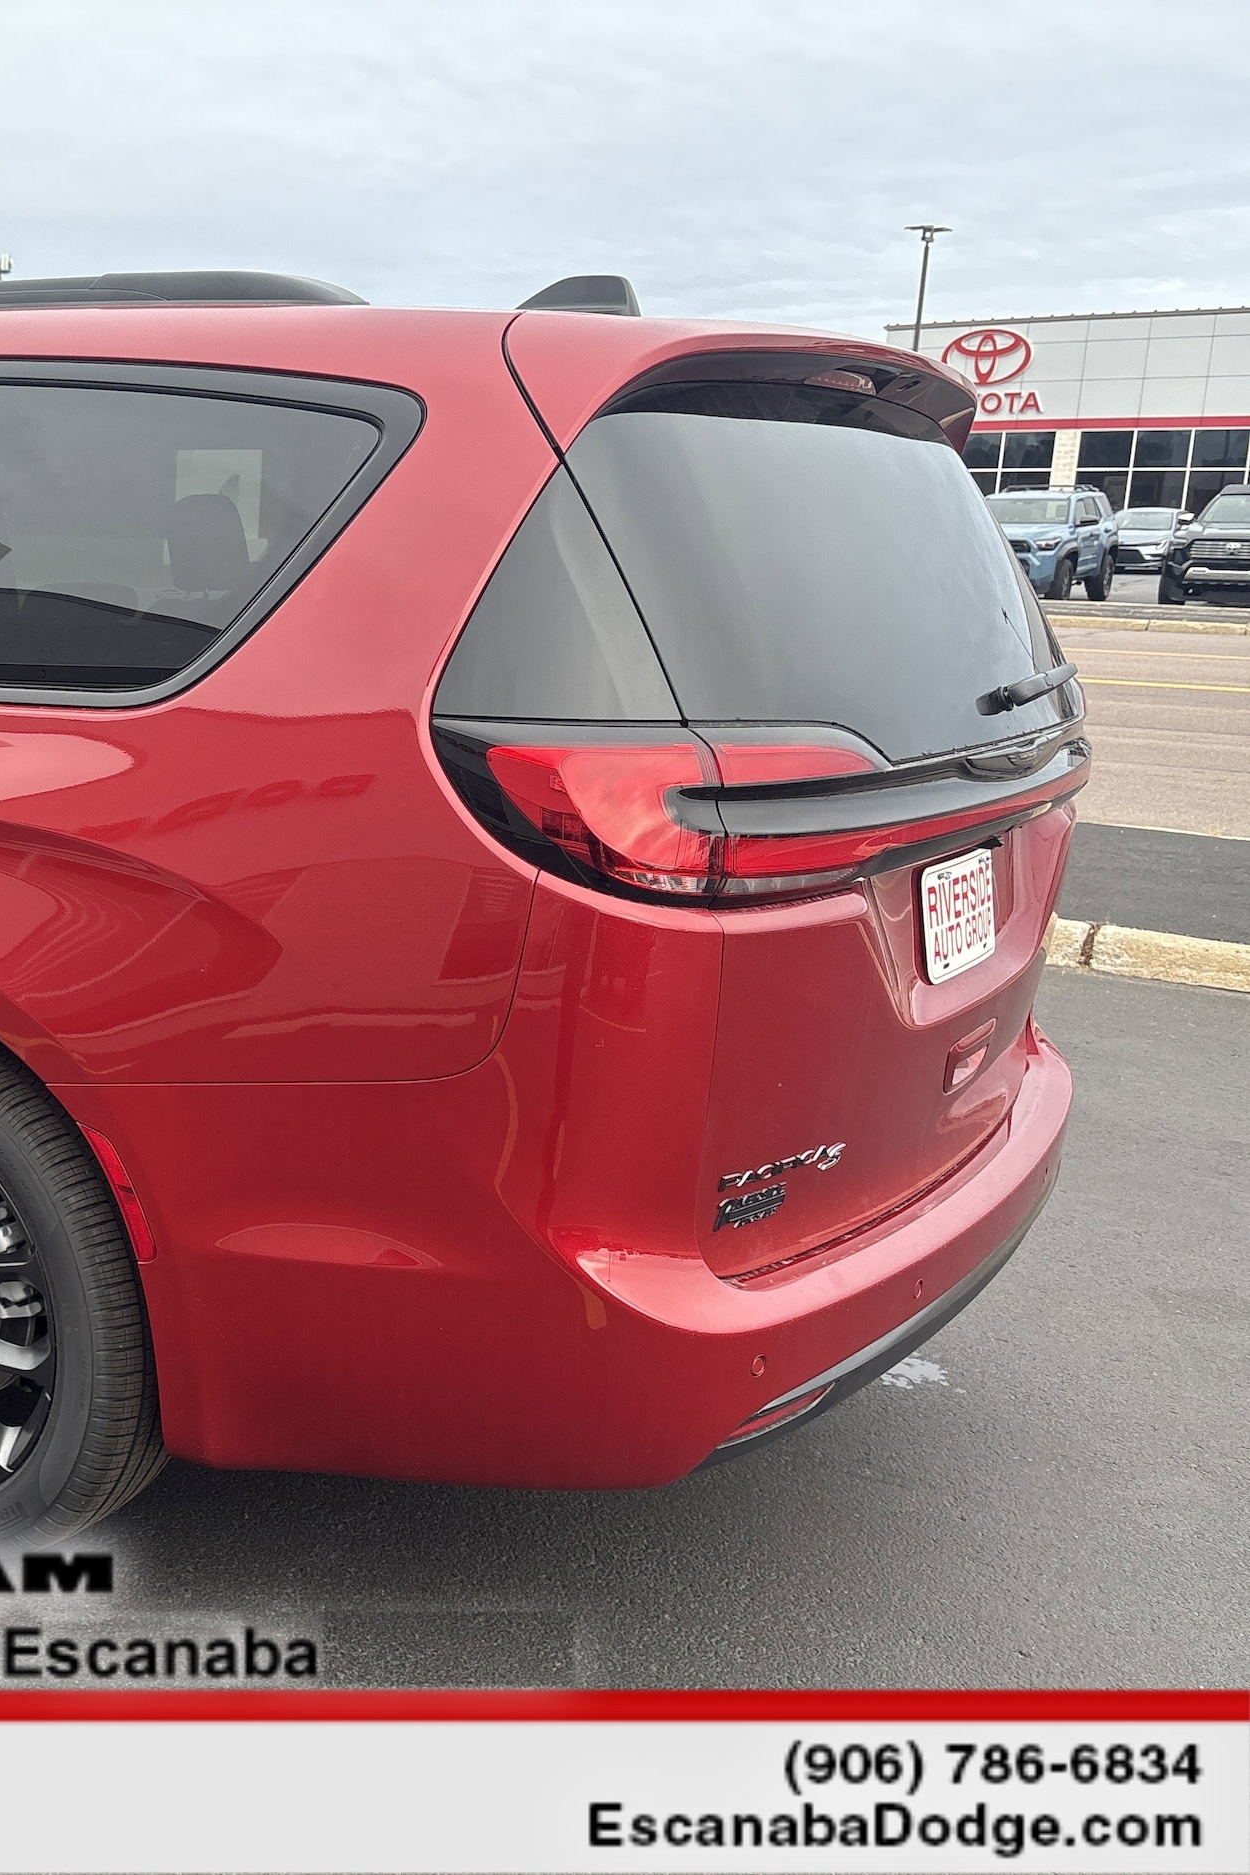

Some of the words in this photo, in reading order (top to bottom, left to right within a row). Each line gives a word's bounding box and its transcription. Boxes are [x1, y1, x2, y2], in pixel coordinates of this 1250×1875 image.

[977, 391, 1043, 415] OTA
[927, 862, 992, 930] RIVERSIDE
[933, 919, 964, 965] AUTO
[964, 905, 992, 950] GROUP
